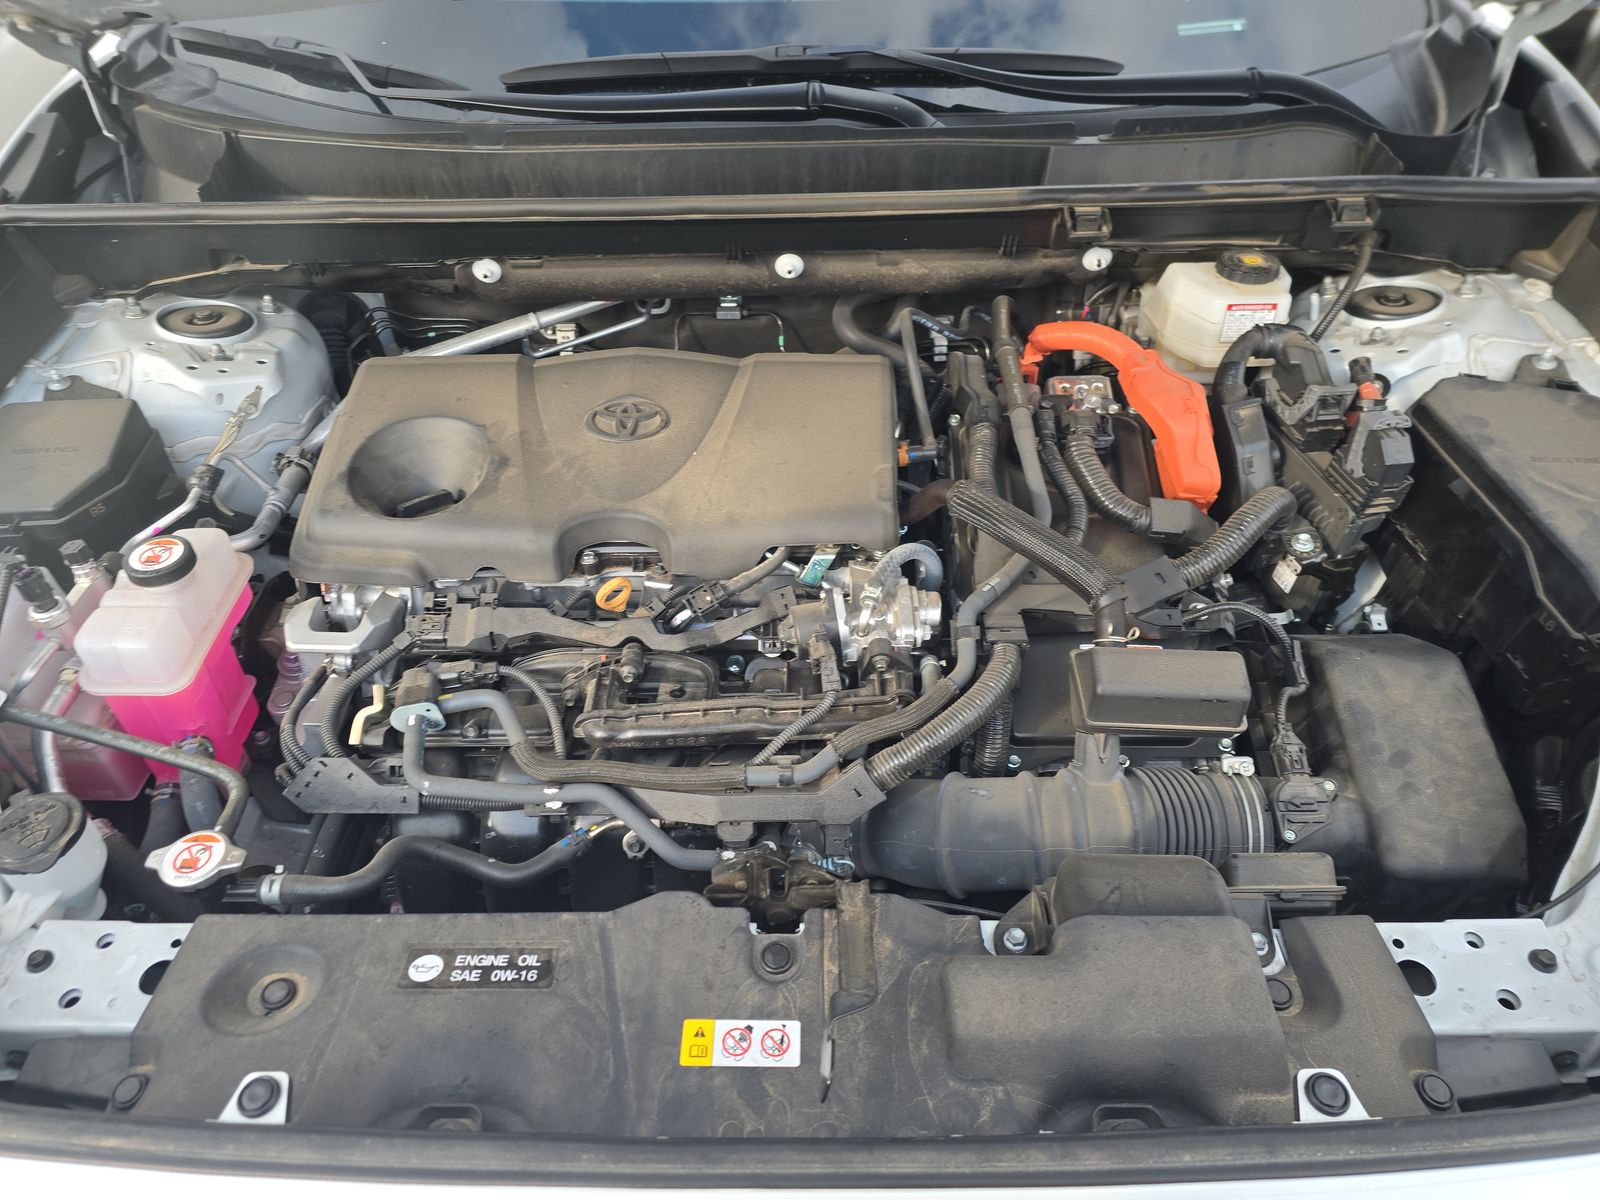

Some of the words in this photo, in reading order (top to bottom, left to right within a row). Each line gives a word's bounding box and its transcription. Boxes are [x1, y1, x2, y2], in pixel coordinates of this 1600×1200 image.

[454, 954, 510, 967] ENGINE
[517, 954, 542, 967] OIL
[449, 969, 482, 982] SAE
[490, 969, 539, 982] 0W-16
